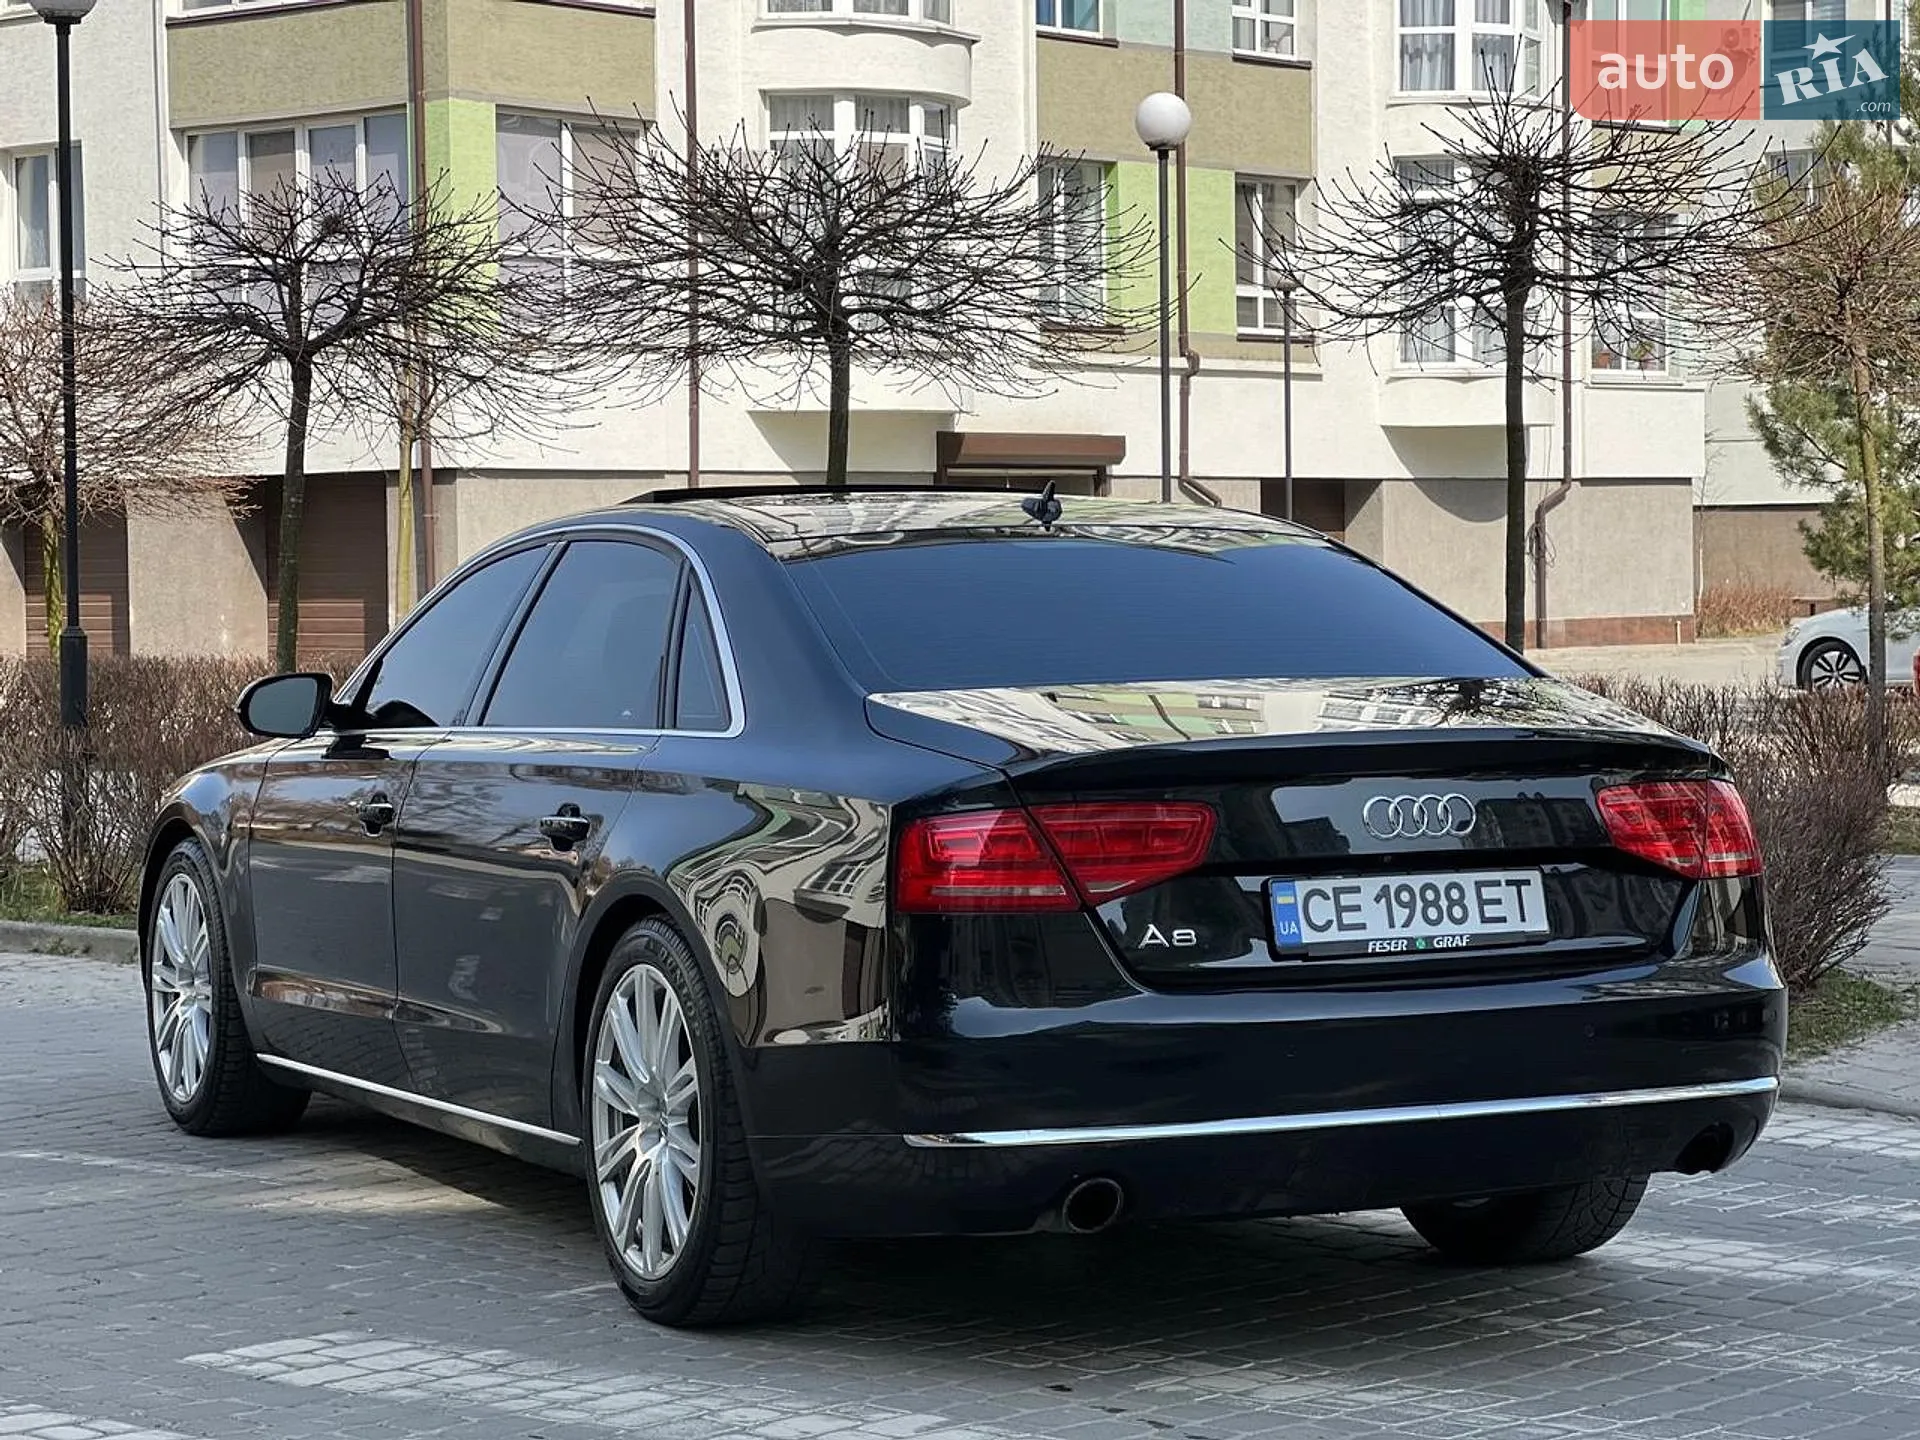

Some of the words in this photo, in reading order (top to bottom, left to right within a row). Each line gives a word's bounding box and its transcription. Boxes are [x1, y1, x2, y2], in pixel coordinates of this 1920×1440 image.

[1302, 885, 1366, 932] CE
[1373, 881, 1469, 929] 1988
[1474, 879, 1531, 924] ET
[1138, 923, 1197, 949] A8
[1279, 920, 1299, 936] UA
[1367, 938, 1408, 953] FESER
[1433, 934, 1471, 948] GRAF
